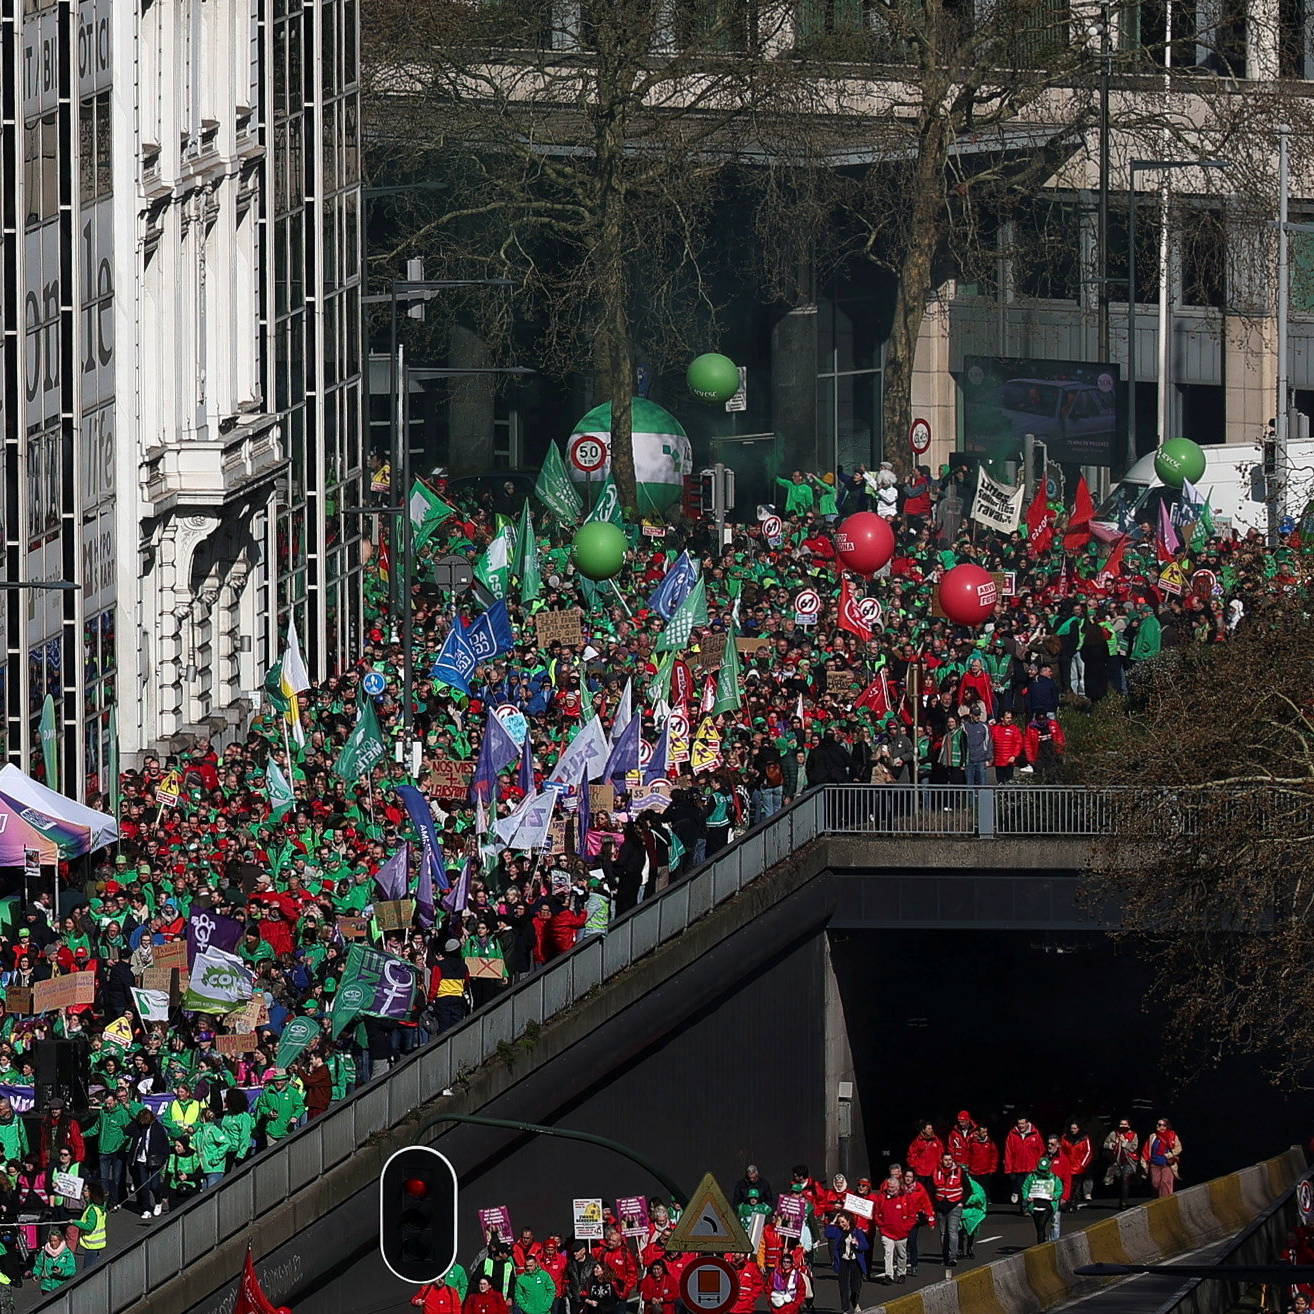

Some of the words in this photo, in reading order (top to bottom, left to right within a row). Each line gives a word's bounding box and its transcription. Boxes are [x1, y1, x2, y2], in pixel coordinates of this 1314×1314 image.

[579, 446, 598, 459] 50
[433, 760, 452, 772] NOS
[454, 762, 474, 773] VIES
